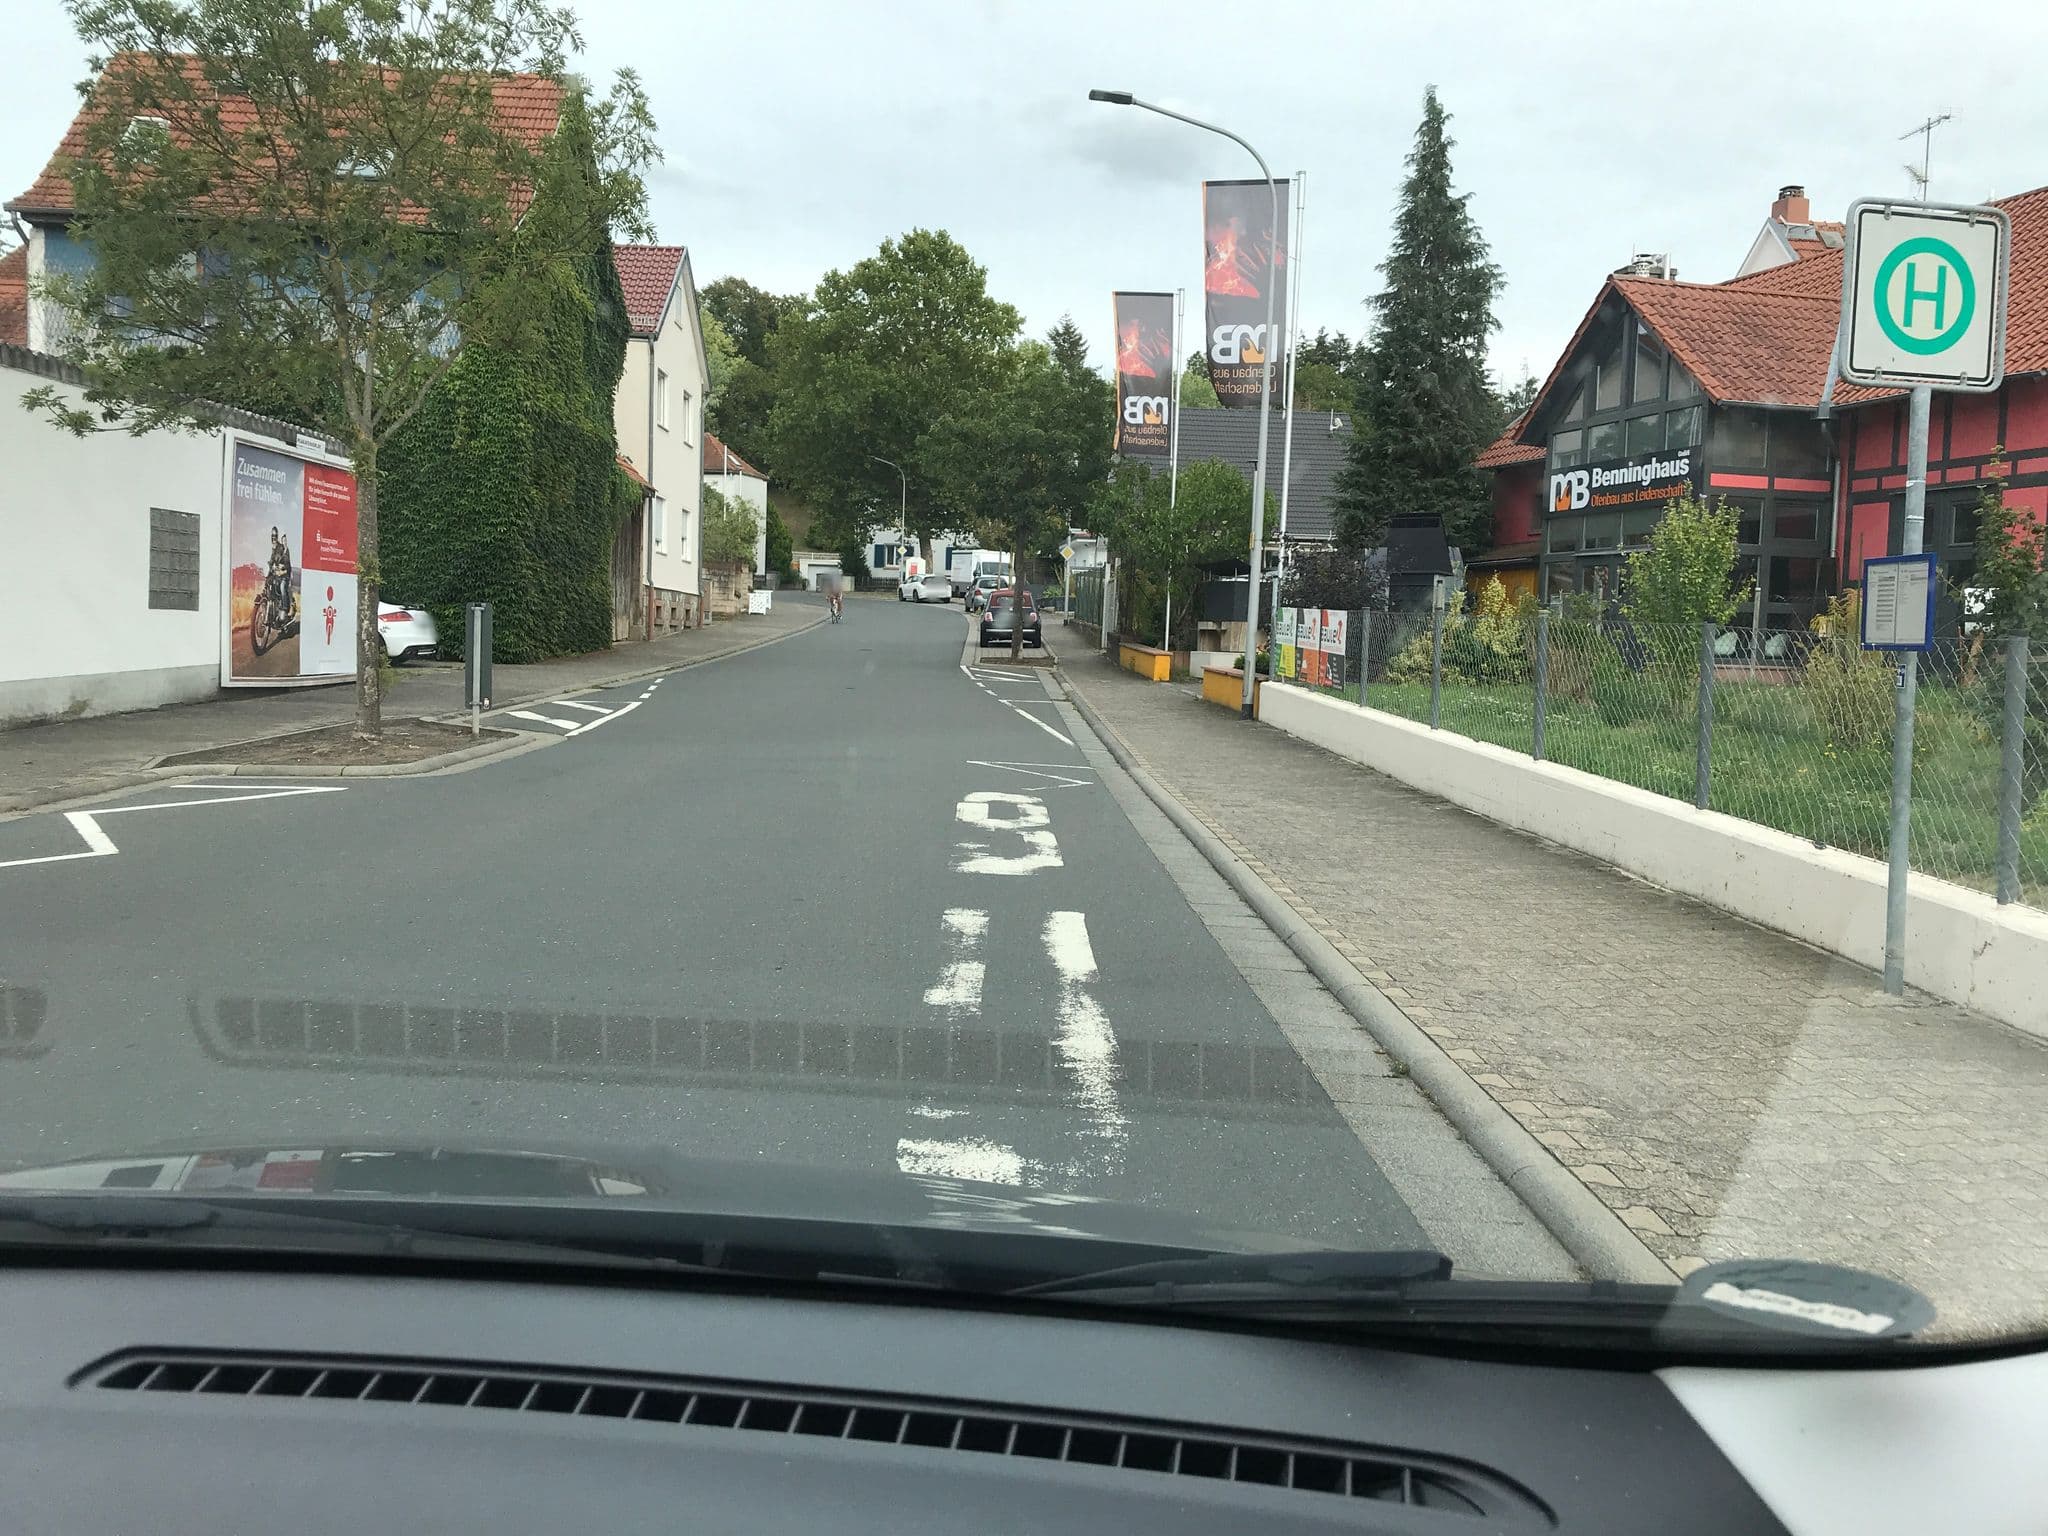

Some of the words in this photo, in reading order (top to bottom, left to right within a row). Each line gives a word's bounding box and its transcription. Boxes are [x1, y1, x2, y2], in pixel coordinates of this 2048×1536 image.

[1904, 262, 1947, 330] H
[236, 457, 286, 484] Zusammen
[1591, 457, 1690, 488] Benninghaus
[236, 479, 253, 499] frei
[254, 481, 284, 505] fühlen.
[1591, 490, 1620, 507] Ofenbau
[1621, 491, 1634, 503] aus
[1635, 483, 1685, 502] Leidenschaft
